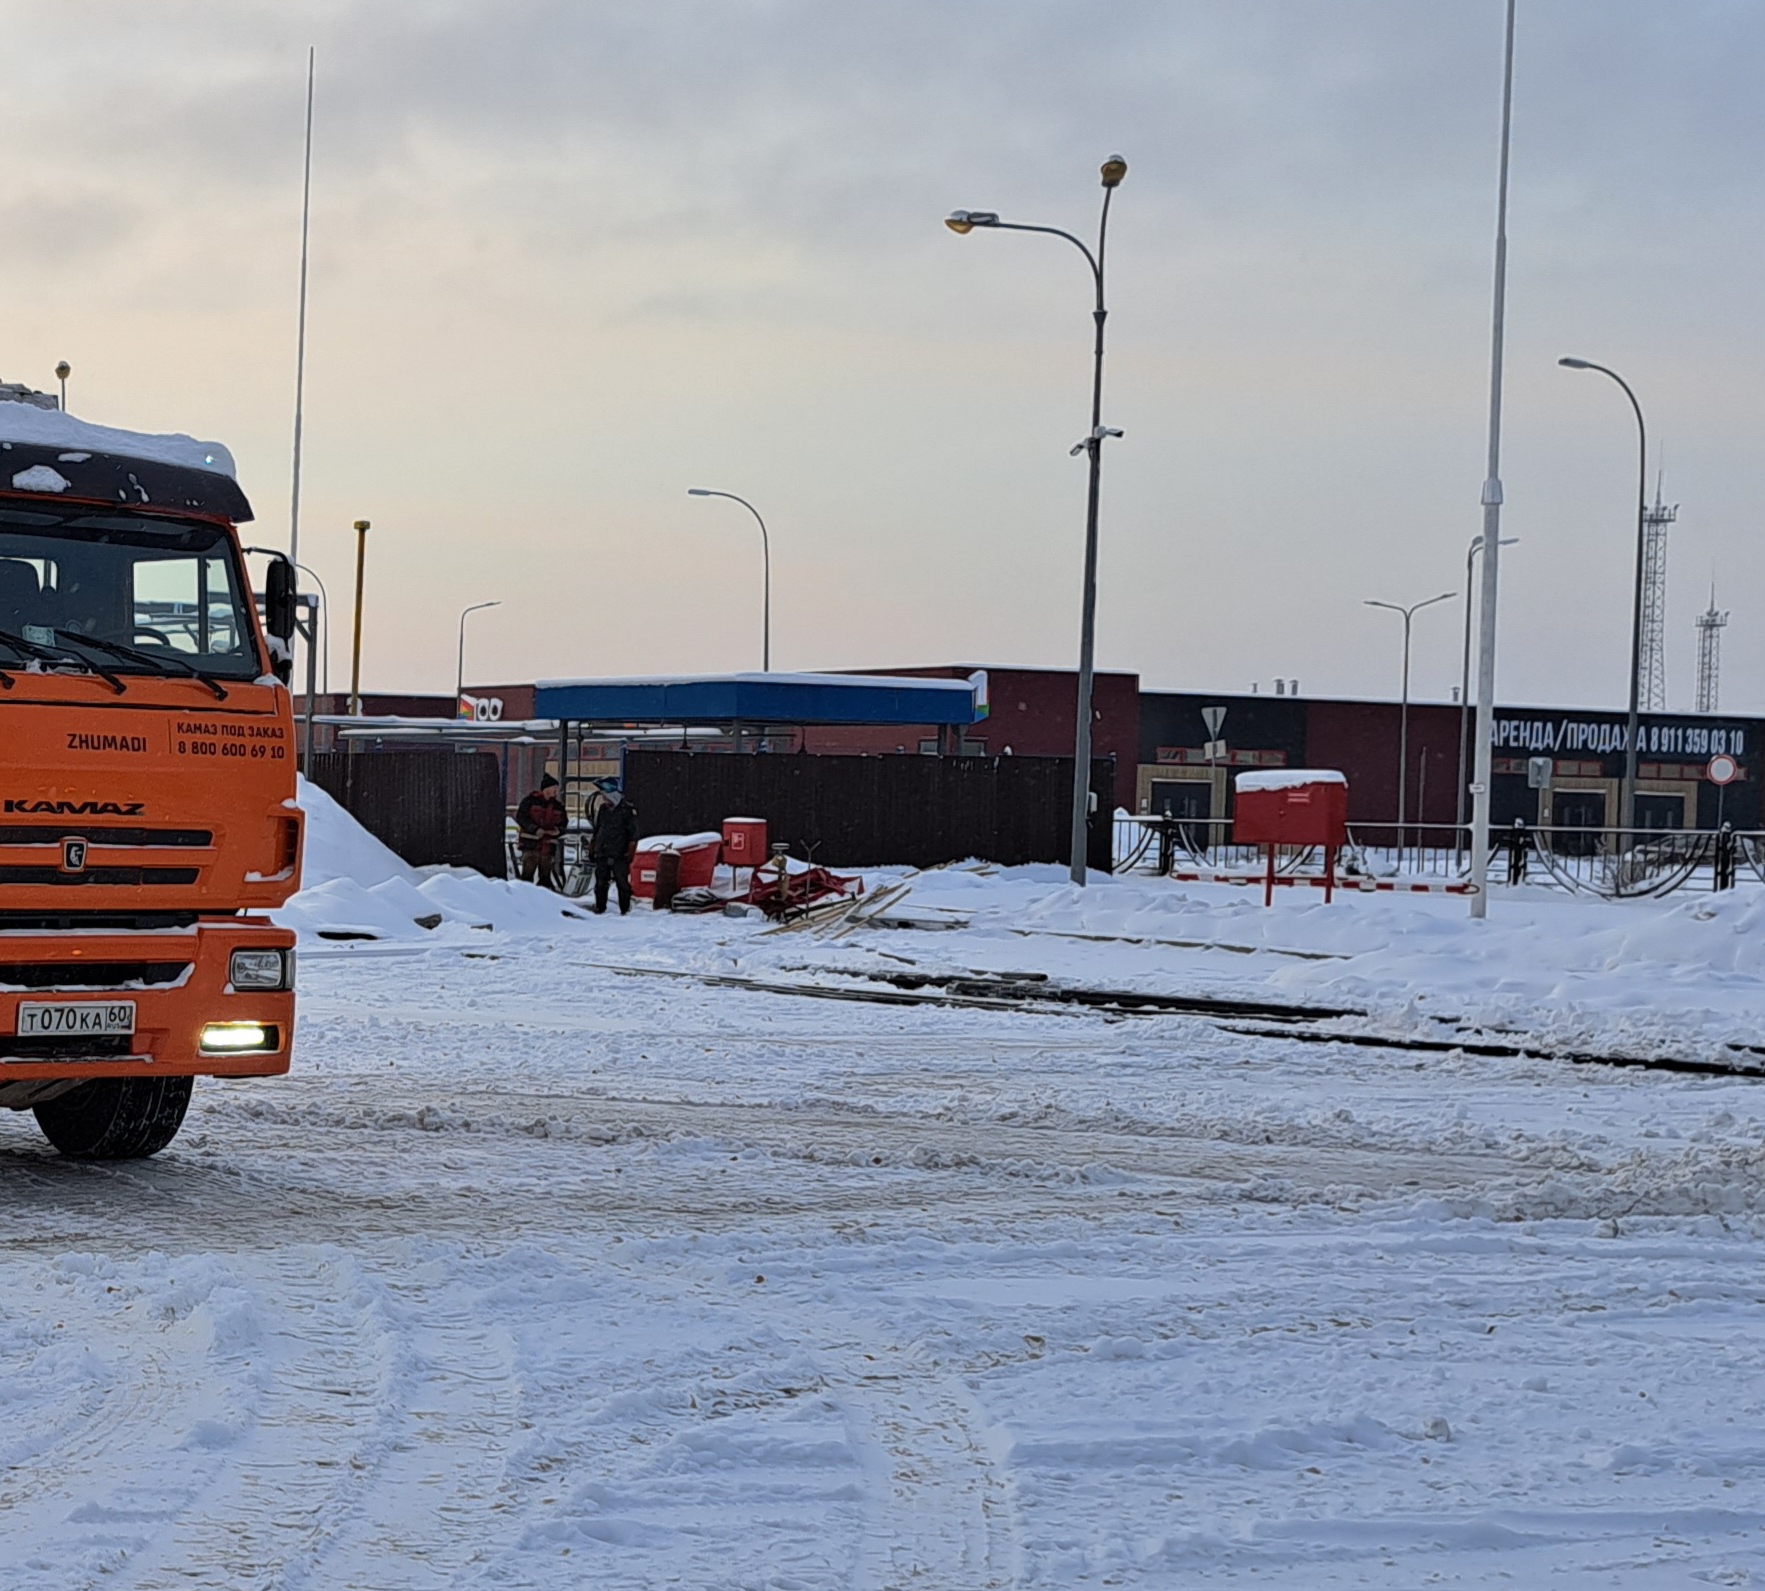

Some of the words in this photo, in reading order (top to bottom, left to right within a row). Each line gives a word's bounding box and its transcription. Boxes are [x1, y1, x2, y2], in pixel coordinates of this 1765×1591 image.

[177, 722, 217, 736] КАМАЗ
[221, 724, 246, 738] ПОД
[248, 725, 284, 739] ЗАКАЗ
[66, 733, 147, 752] ZHUMADI
[178, 740, 186, 754] 8
[191, 741, 216, 756] 800
[221, 743, 246, 757] 600
[250, 744, 266, 758] 69
[270, 745, 284, 759] 10
[1650, 726, 1659, 752] 8
[1661, 726, 1683, 752] 911
[1685, 727, 1709, 754] 359
[1710, 729, 1727, 754] 03
[1729, 729, 1744, 755] 10
[3, 799, 145, 815] KAMAZ
[108, 1006, 127, 1022] 60
